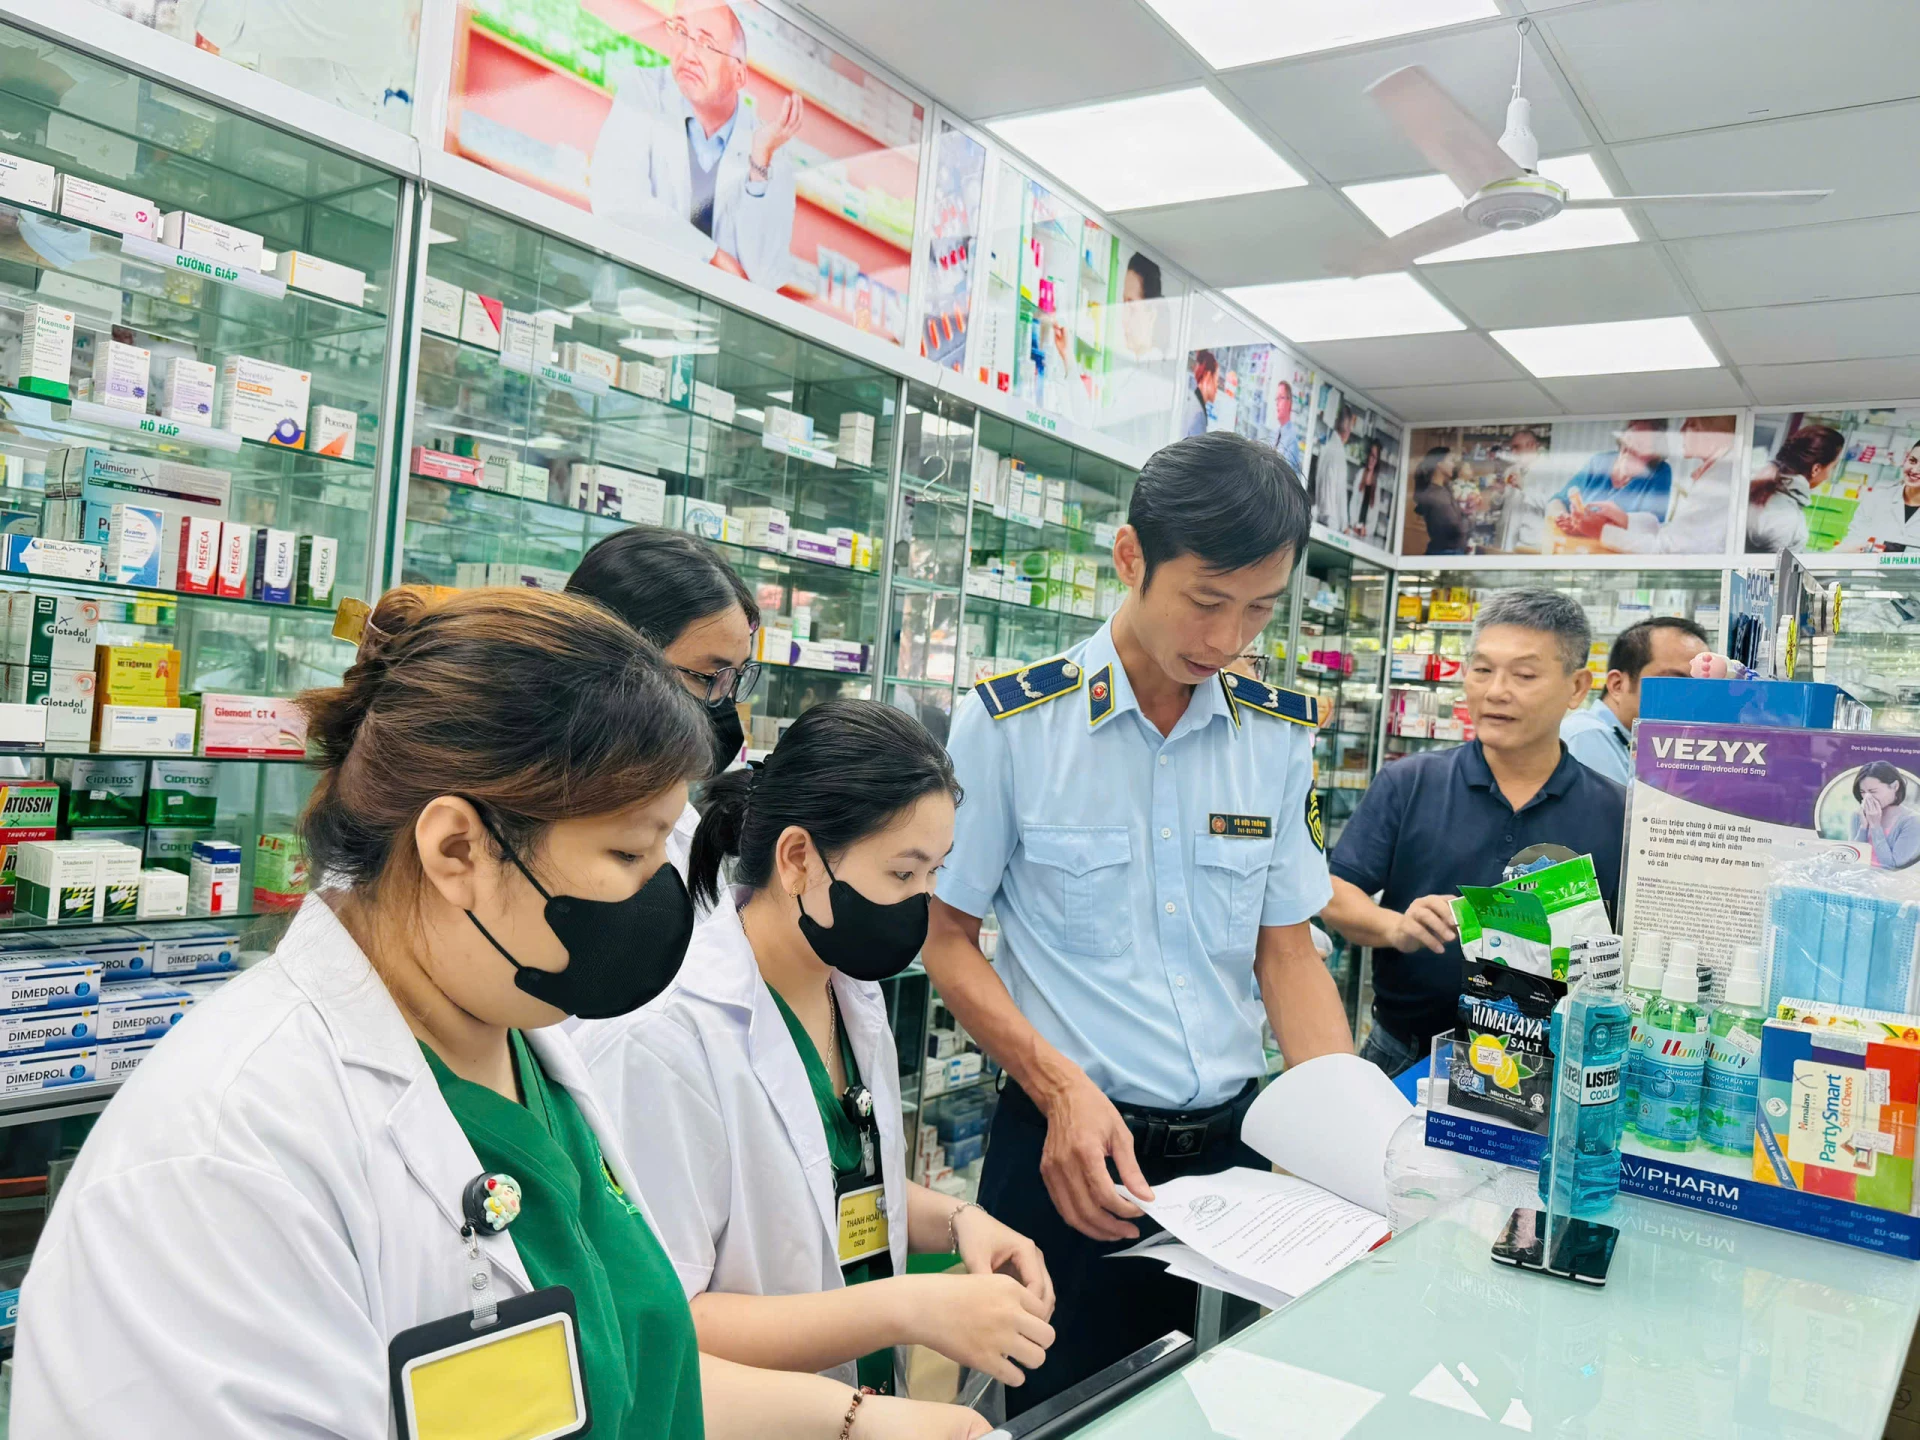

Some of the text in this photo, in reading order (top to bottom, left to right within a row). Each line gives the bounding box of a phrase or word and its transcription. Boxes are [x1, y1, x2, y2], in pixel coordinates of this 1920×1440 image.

[176, 254, 238, 281] CƯỜNG GIÁP
[140, 418, 180, 437] HÔ HẤP
[94, 460, 137, 476] Pulmicort
[43, 543, 98, 557] BILAXTEN
[198, 530, 210, 570] MESECA
[231, 535, 241, 575] MESECA
[277, 541, 287, 578] MESECA
[46, 625, 88, 637] Glotadol
[41, 698, 83, 708] Glotadol
[270, 711, 276, 719] 4
[1651, 736, 1768, 766] VEZYX
[1656, 761, 1766, 777] Levocetirizin dihydroclorid 5mg
[86, 775, 134, 785] CIDETUSS
[164, 775, 211, 785] CIDETUSS
[4, 796, 54, 813] ATUSSIN
[167, 954, 214, 965] DIMEDROL
[1589, 951, 1620, 964] LISTERINE
[12, 985, 70, 1000] DIMEDROL
[113, 1015, 165, 1030] DIMEDROL
[1472, 1004, 1543, 1041] HIMALAYA
[8, 1027, 67, 1042] DIMEDROL
[1510, 1038, 1542, 1053] SALT
[6, 1068, 65, 1084] DIMEDROL
[1490, 1089, 1504, 1099] Mint
[1505, 1092, 1526, 1106] Candy
[1840, 1076, 1853, 1129] Soft Chews
[1429, 1116, 1456, 1128] EU-GMP
[1819, 1073, 1843, 1163] PartySmart
[1446, 1130, 1473, 1142] EU-GMP
[1470, 1125, 1497, 1136] EU-GMP
[1428, 1136, 1454, 1147] EU-GMP
[1487, 1140, 1515, 1151] EU-GMP
[1468, 1145, 1495, 1156] EU-GMP
[1648, 1182, 1658, 1192] of
[1662, 1186, 1702, 1202] Adamed
[1707, 1196, 1739, 1212] Group
[847, 1217, 865, 1228] THANH
[1850, 1209, 1886, 1224] EU-GMP
[1848, 1232, 1885, 1247] EU-GMP
[1873, 1226, 1910, 1242] EU-GMP
